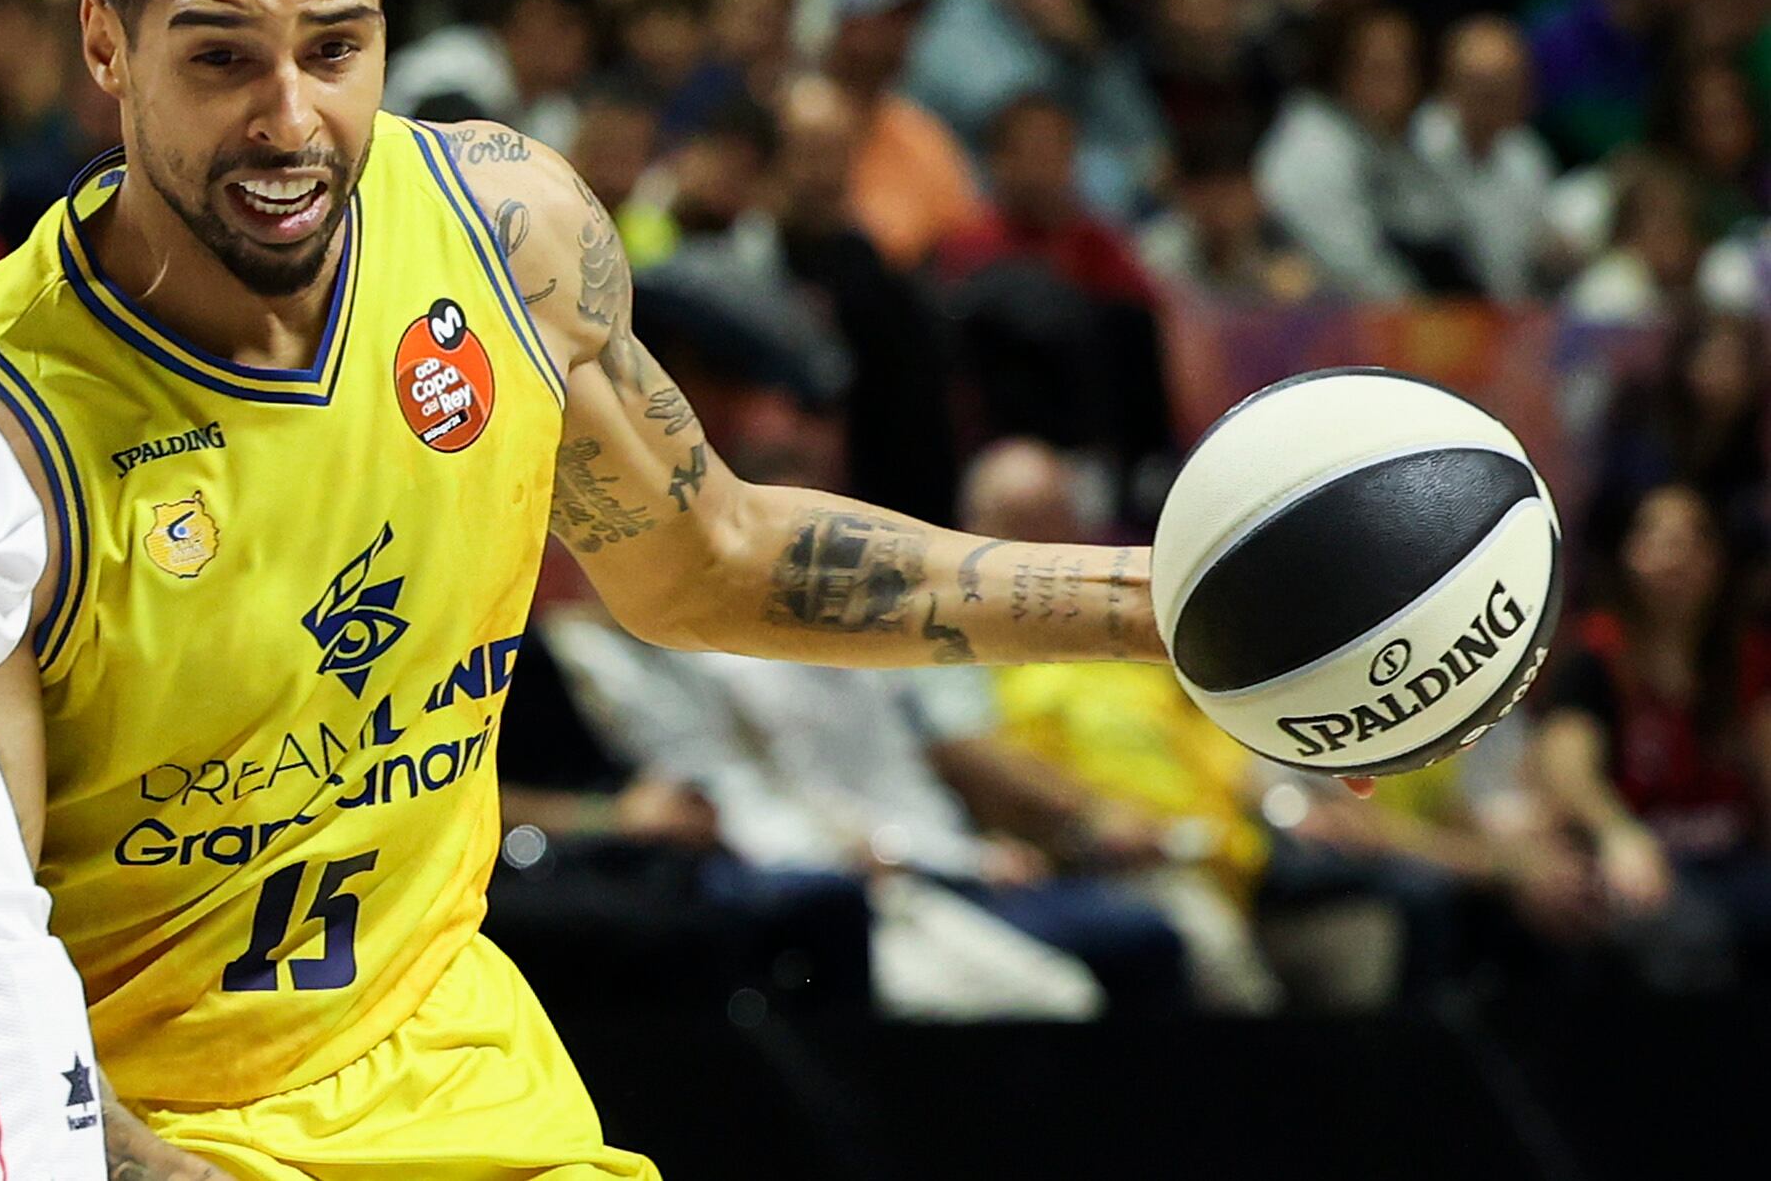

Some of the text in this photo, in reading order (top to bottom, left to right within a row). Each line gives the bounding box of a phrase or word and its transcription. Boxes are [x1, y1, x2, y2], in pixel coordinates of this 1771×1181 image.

[411, 365, 460, 403] Copa
[439, 383, 472, 415] Rey
[111, 421, 227, 480] SPALDING
[1277, 579, 1527, 757] SPALDING
[222, 849, 380, 993] 15
